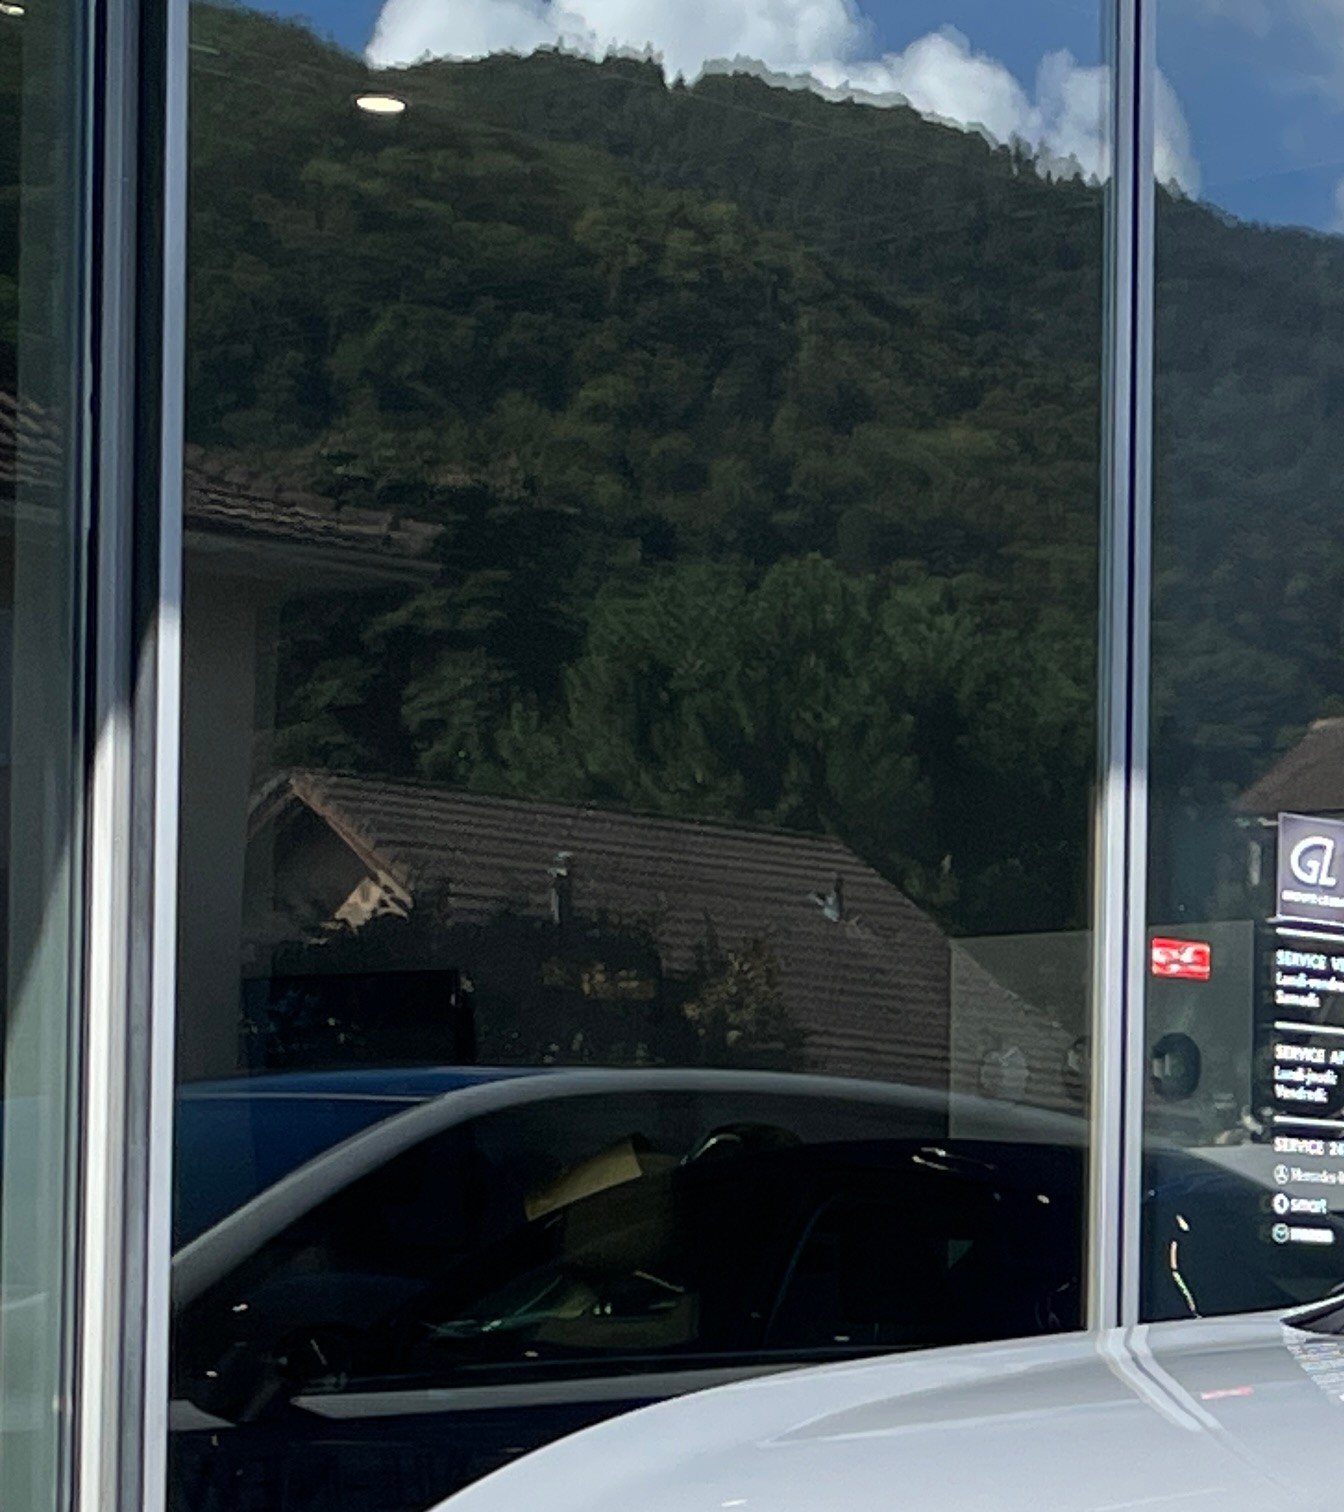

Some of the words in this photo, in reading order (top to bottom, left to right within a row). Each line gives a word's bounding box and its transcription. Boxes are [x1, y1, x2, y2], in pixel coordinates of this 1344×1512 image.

[1290, 835, 1337, 887] GL
[1276, 950, 1326, 970] SERVICE
[1275, 1044, 1325, 1063] SERVICE
[1274, 1137, 1324, 1155] SERVICE
[1290, 1198, 1327, 1214] smart
